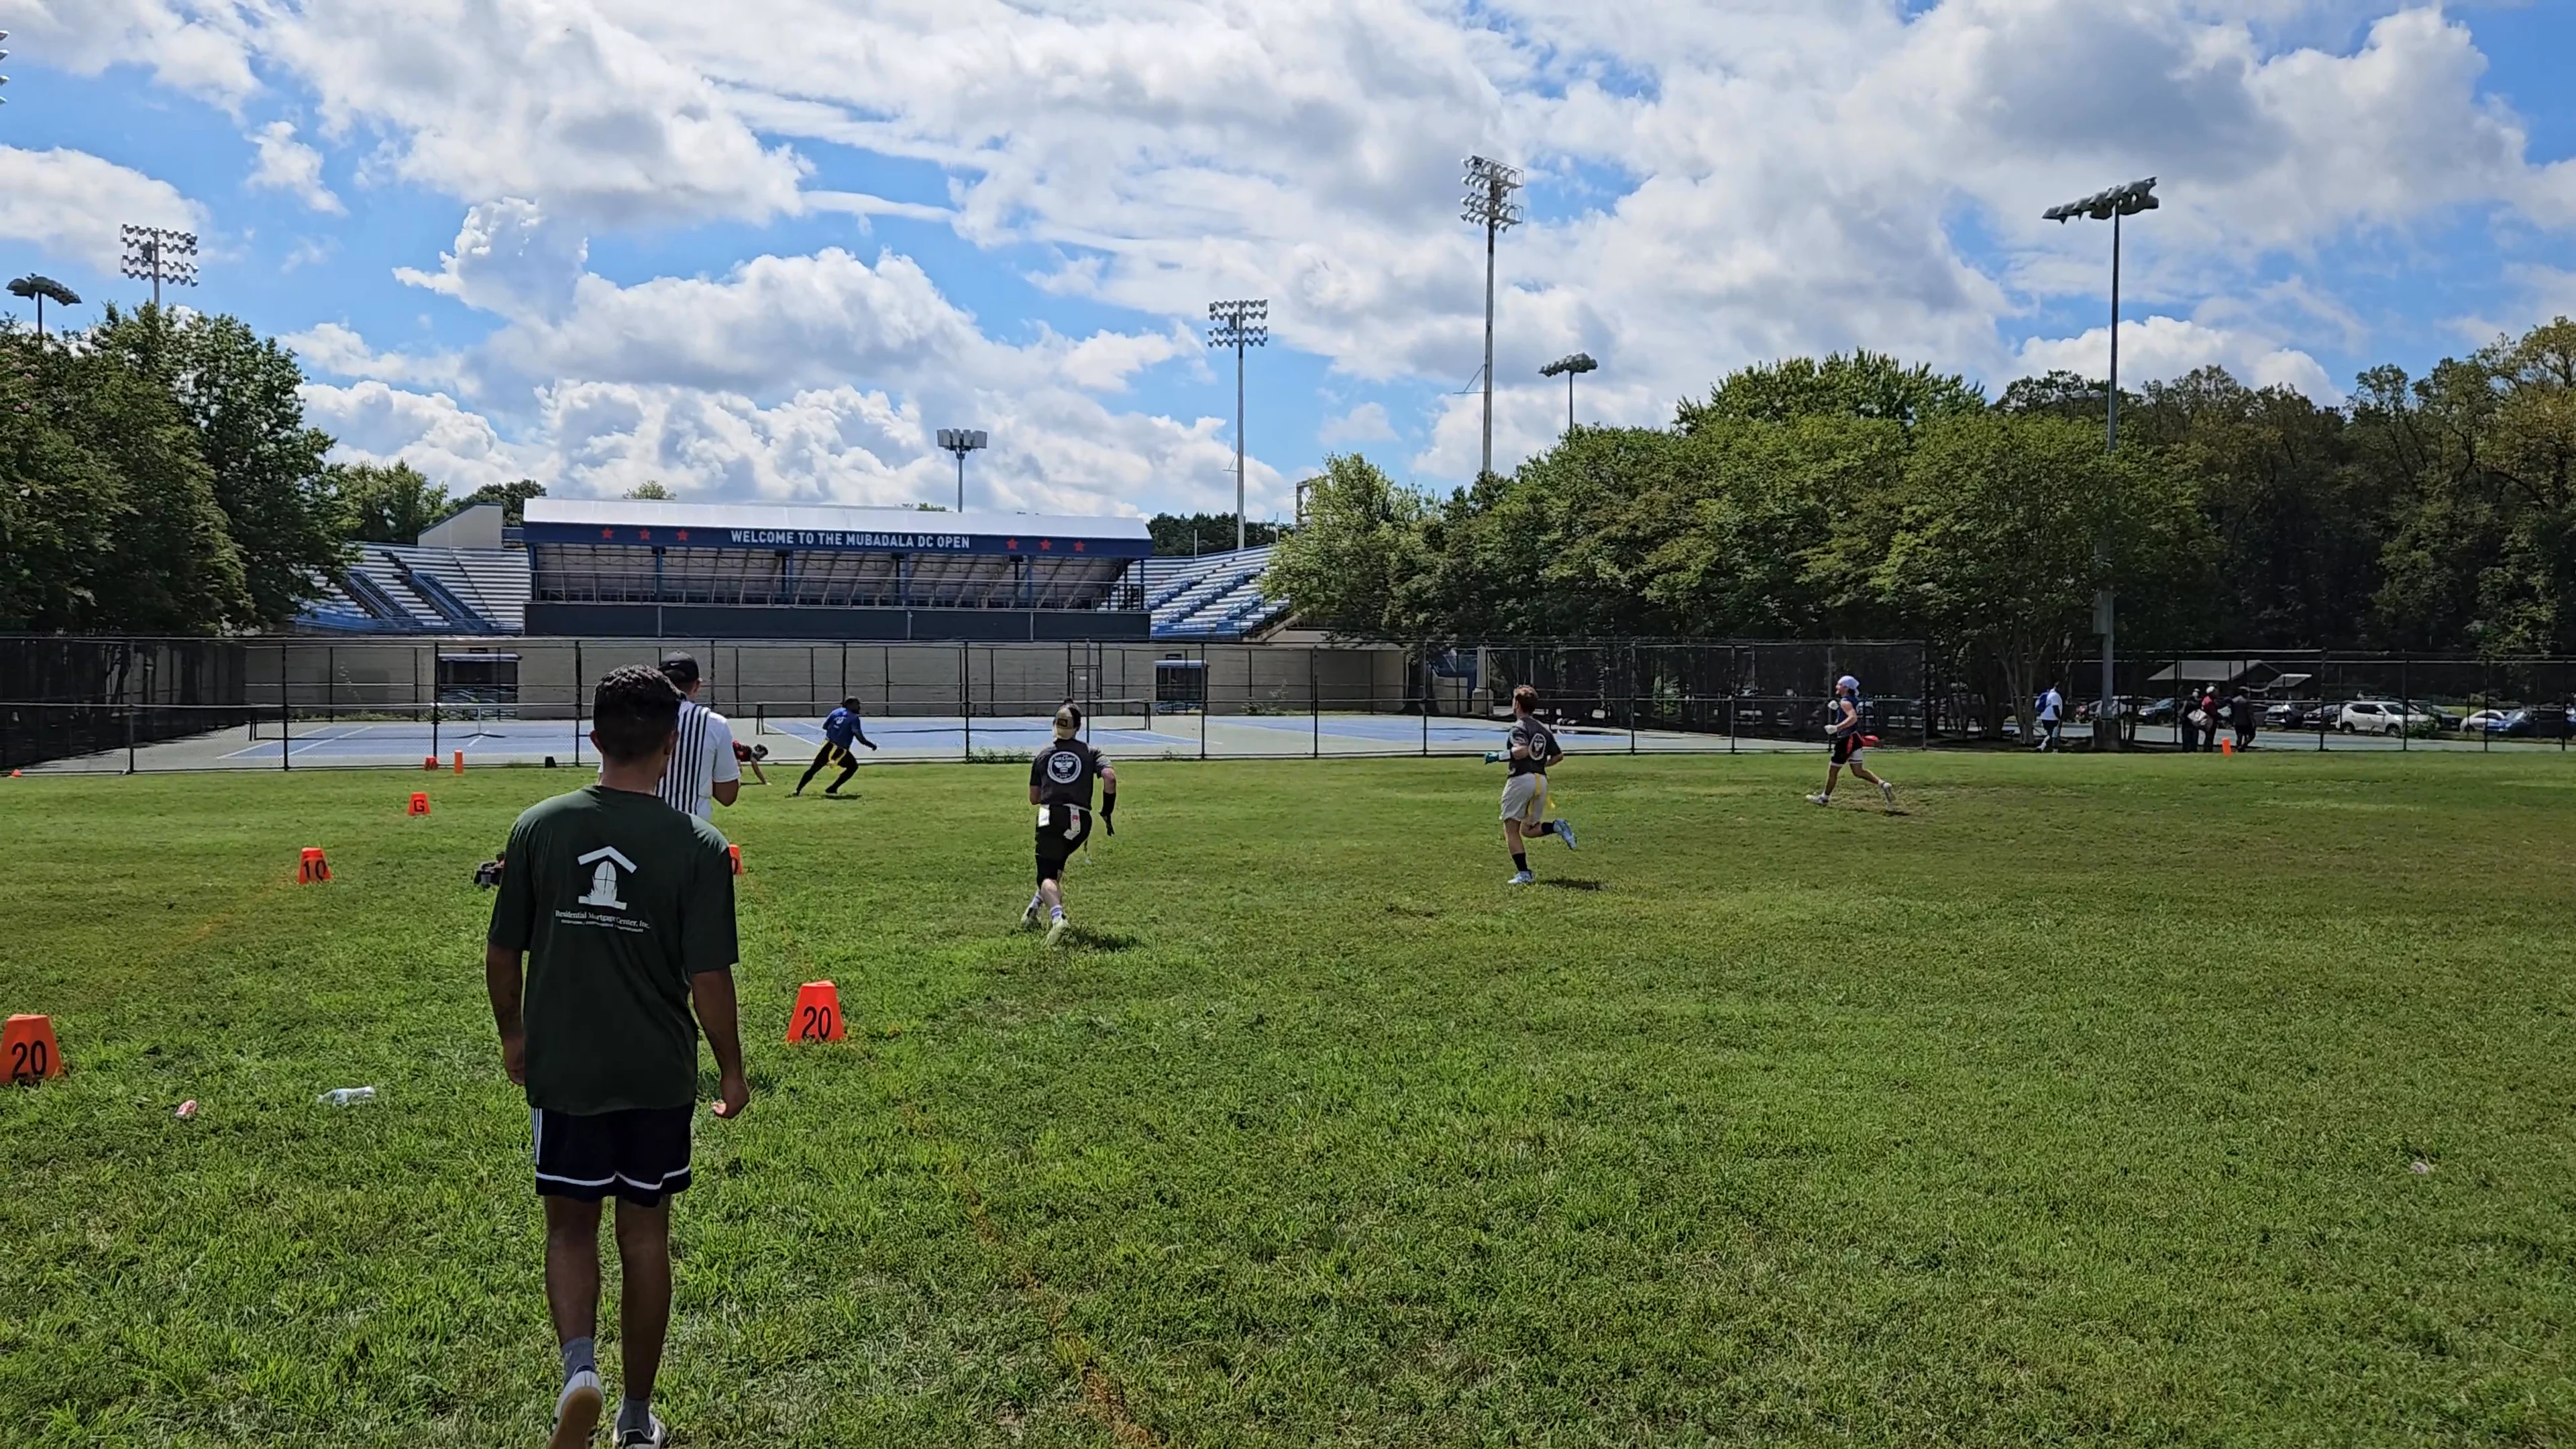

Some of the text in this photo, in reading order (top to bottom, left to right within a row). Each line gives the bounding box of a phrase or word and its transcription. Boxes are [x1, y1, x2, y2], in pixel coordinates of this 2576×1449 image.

[731, 530, 969, 548] WELCOME TO THE MUBADALA DC OPEN
[413, 799, 425, 812] G
[303, 860, 327, 881] 10
[555, 910, 587, 919] Residential
[802, 1006, 831, 1040] 20
[11, 1040, 47, 1079] 20
